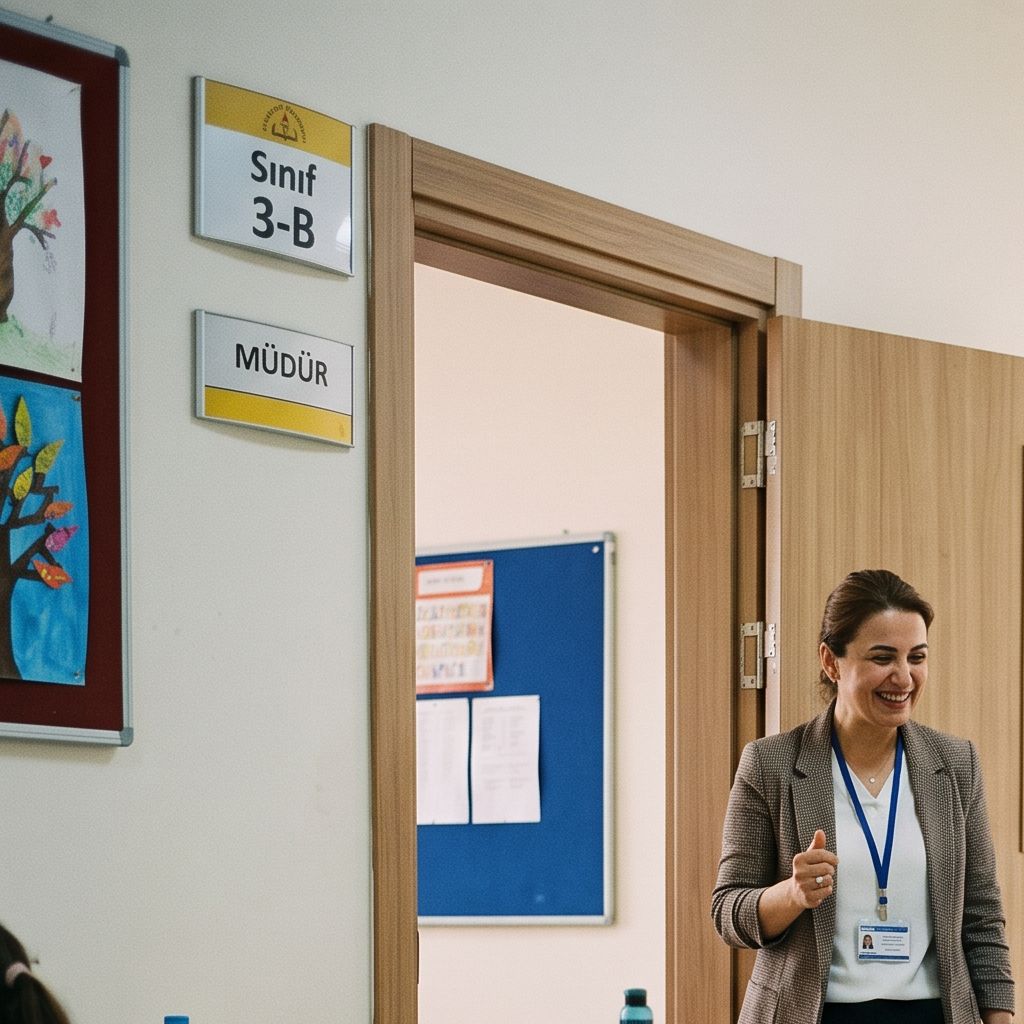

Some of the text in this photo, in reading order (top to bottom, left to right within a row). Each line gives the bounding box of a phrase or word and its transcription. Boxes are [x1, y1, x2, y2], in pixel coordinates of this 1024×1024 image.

[251, 150, 317, 197] Sınıf
[252, 195, 315, 249] 3-B
[235, 342, 328, 387] MÜDÜR
